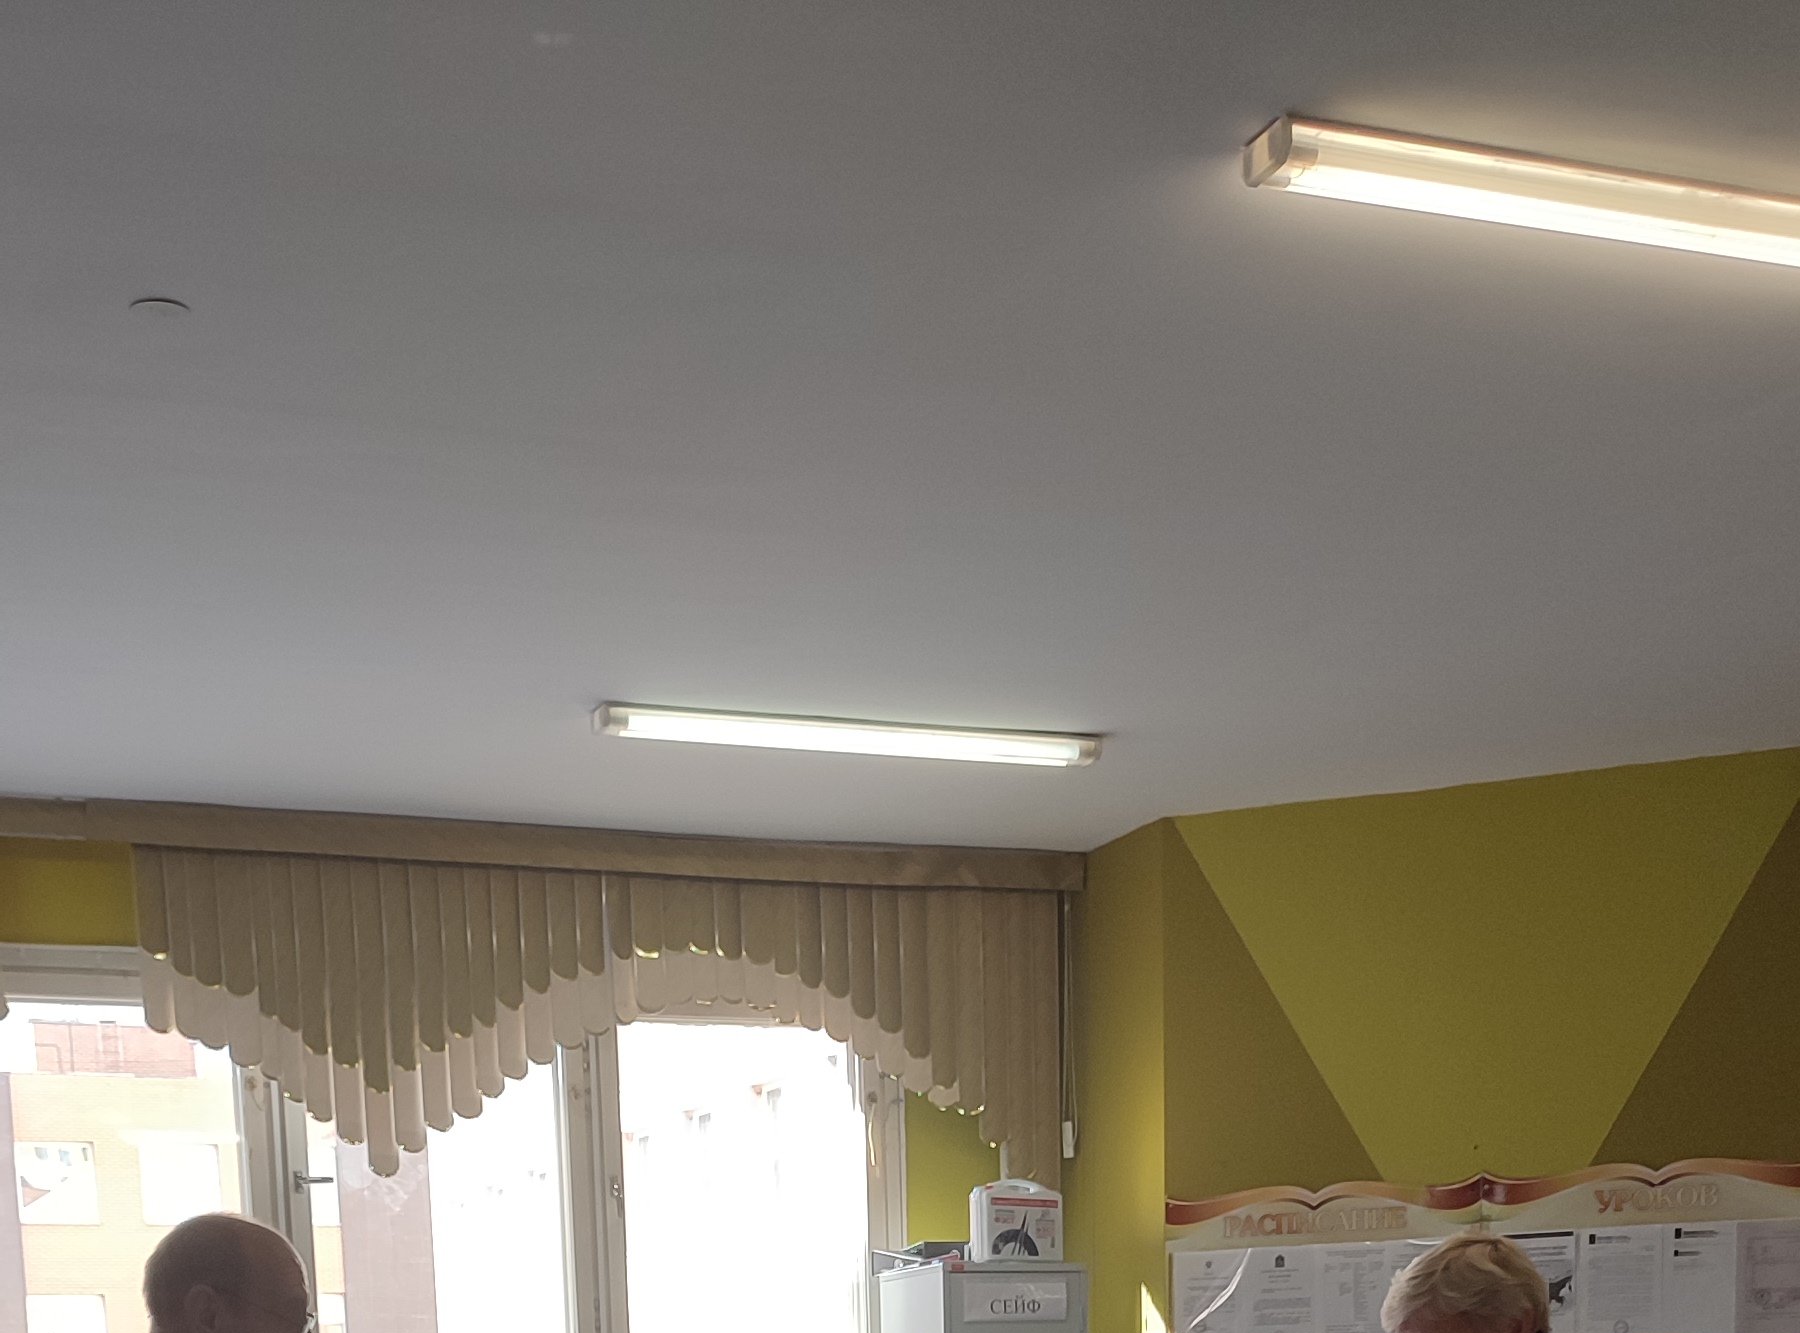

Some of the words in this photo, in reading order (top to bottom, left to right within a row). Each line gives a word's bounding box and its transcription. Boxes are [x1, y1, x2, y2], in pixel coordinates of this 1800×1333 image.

[1223, 1206, 1408, 1238] РАСПИСАНИЕ
[1593, 1182, 1719, 1213] УРОКОВ
[990, 1295, 1041, 1315] СЕЙФ
